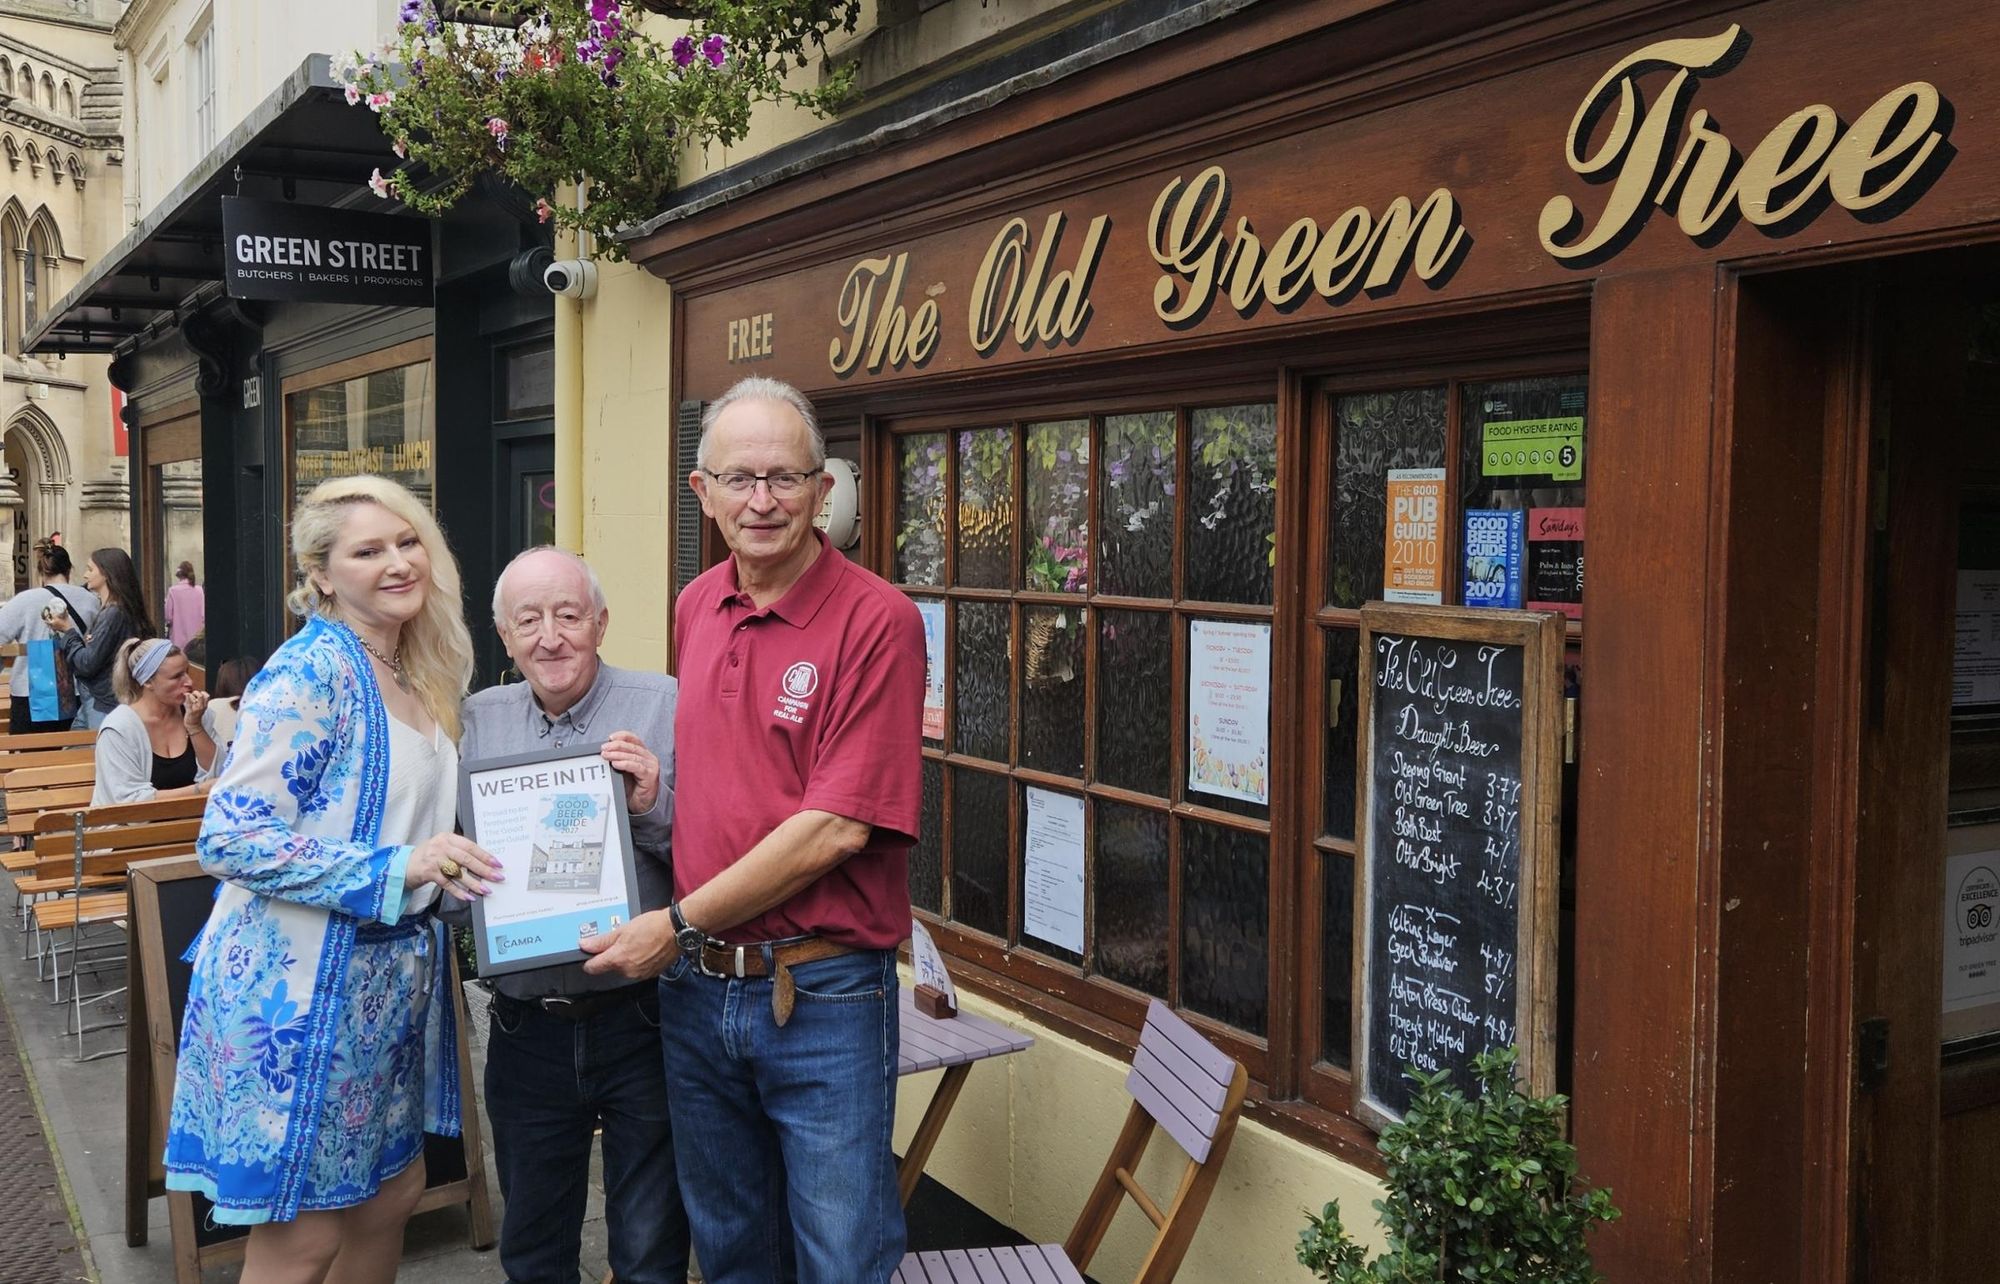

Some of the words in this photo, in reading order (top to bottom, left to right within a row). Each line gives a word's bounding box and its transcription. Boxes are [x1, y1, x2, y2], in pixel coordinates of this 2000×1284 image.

[829, 252, 940, 373] The
[969, 211, 1110, 352] Old
[1148, 166, 1468, 323] Green
[1538, 24, 1944, 260] Tree
[236, 234, 321, 266] GREEN
[328, 240, 422, 272] STREET
[237, 269, 294, 280] BUTCHERS
[309, 273, 350, 283] BAKERS
[363, 275, 424, 287] PROVISIONS
[728, 312, 774, 362] FREE
[1489, 425, 1511, 436] FOOD
[1513, 424, 1548, 435] HYGIENE
[1549, 422, 1578, 433] RATING
[392, 440, 431, 472] LUNCH
[1562, 448, 1573, 465] 5
[1396, 485, 1412, 497] THE
[1413, 485, 1438, 496] GOOD
[1394, 497, 1438, 522] PUB
[1467, 517, 1508, 530] GOOD
[1511, 511, 1521, 529] We
[1393, 522, 1437, 541] GUIDE
[1467, 530, 1507, 544] BEER
[1393, 540, 1437, 565] 2010
[1466, 544, 1507, 557] GUIDE
[1511, 554, 1520, 564] in
[1465, 582, 1506, 598] 2007
[1377, 636, 1404, 689] The
[1405, 640, 1436, 700] Old
[1434, 646, 1475, 714] Green
[1478, 646, 1522, 709] Tree
[773, 709, 790, 720] REAL
[790, 714, 804, 723] ALE
[784, 705, 798, 714] FOR
[1395, 703, 1457, 762] Draught
[1454, 720, 1500, 757] Beer
[477, 772, 550, 797] WE'RE
[553, 768, 575, 786] IN
[580, 764, 606, 783] IT!
[1432, 760, 1466, 790] Giant
[556, 800, 590, 809] GOOD
[1395, 780, 1413, 806] Old
[1415, 786, 1445, 818] Green
[1443, 790, 1470, 818] Tree
[553, 818, 588, 827] GUIDE
[557, 809, 584, 818] BEER
[1418, 816, 1442, 843] Best
[1396, 839, 1423, 869] Otter
[1421, 846, 1461, 884] Bright
[1961, 889, 1999, 901] EXCELLENCE
[503, 935, 543, 949] CAMRA
[1959, 932, 1996, 947] tripadvisor
[1389, 973, 1424, 1010] Ashton
[1424, 987, 1448, 1015] Press
[1452, 997, 1480, 1027] Cider
[1427, 1019, 1465, 1057] Midford
[1390, 1034, 1408, 1060] Old
[1407, 1040, 1440, 1072] Rosie
